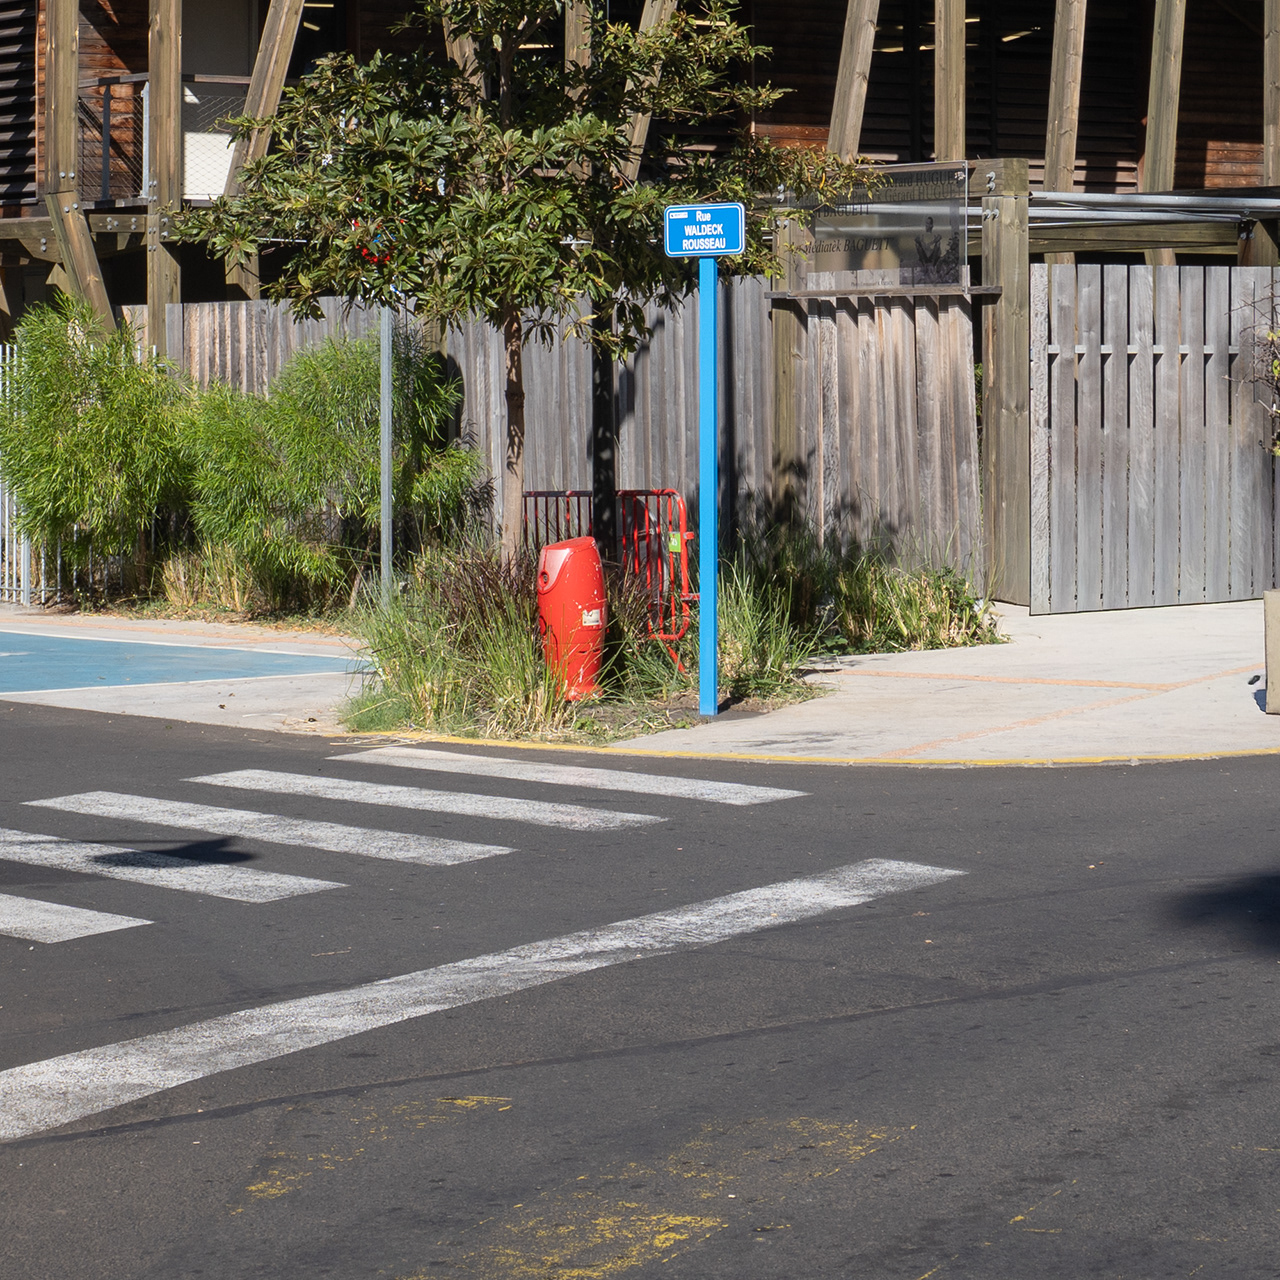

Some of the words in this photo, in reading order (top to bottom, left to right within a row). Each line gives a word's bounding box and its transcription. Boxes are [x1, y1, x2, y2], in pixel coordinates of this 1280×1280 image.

[915, 170, 961, 187] HUGUE
[696, 210, 711, 222] Rue
[684, 223, 724, 236] WALDECK
[682, 237, 726, 250] ROUSSEAU
